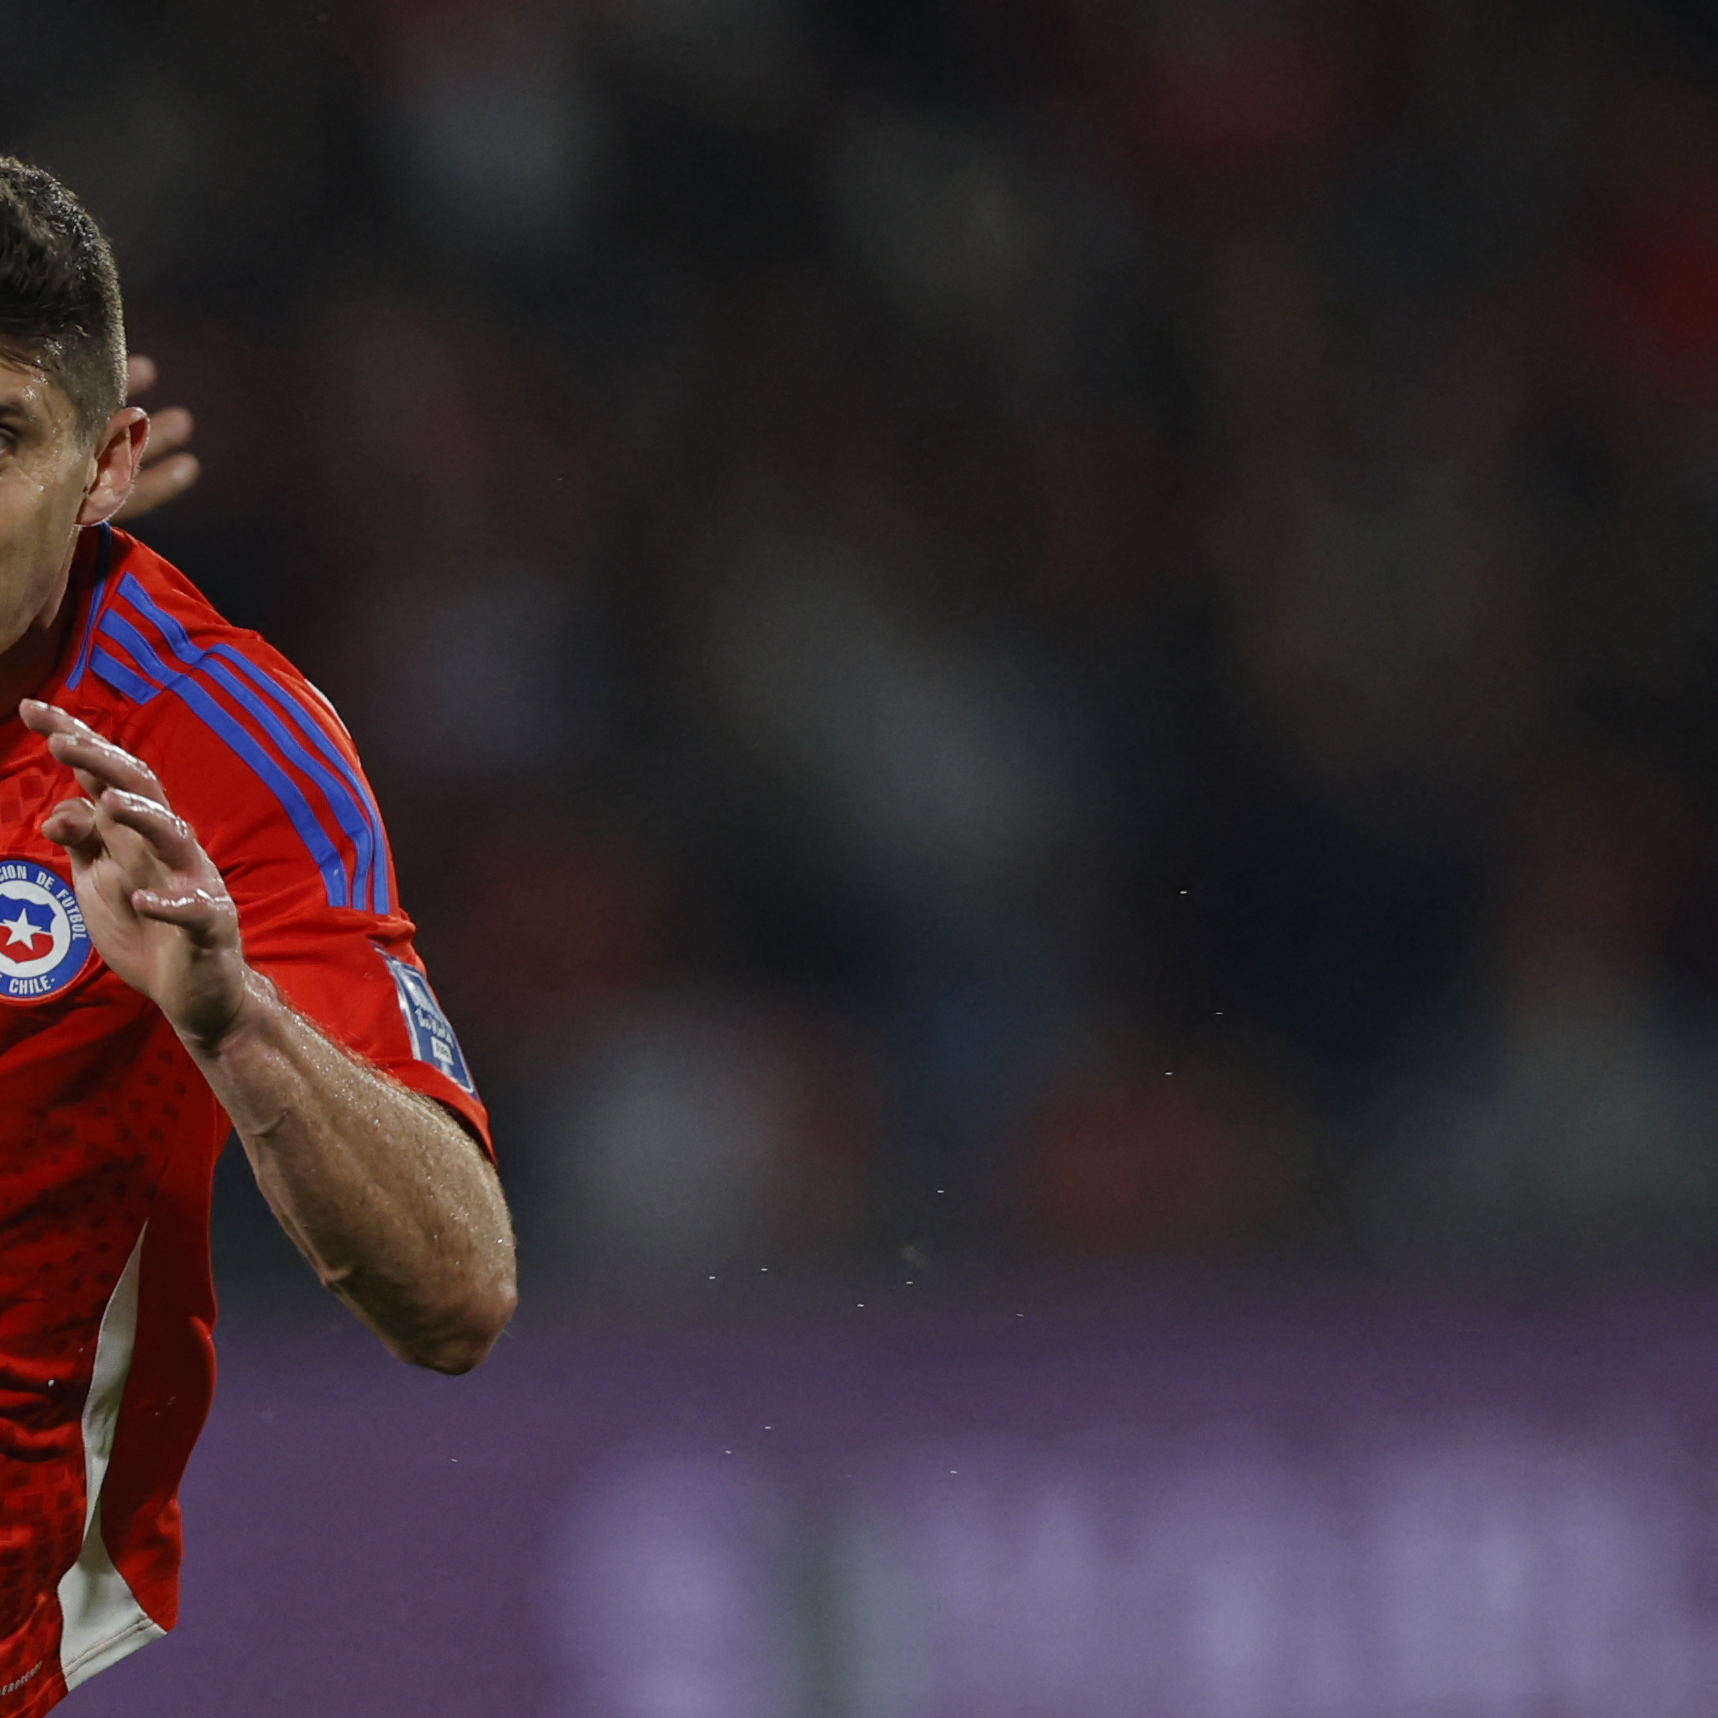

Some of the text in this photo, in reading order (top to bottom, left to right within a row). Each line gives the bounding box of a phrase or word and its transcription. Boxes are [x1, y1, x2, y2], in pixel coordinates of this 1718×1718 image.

[36, 871, 55, 891] DE
[56, 889, 87, 941] FUTBOL
[9, 975, 52, 995] CHILE
